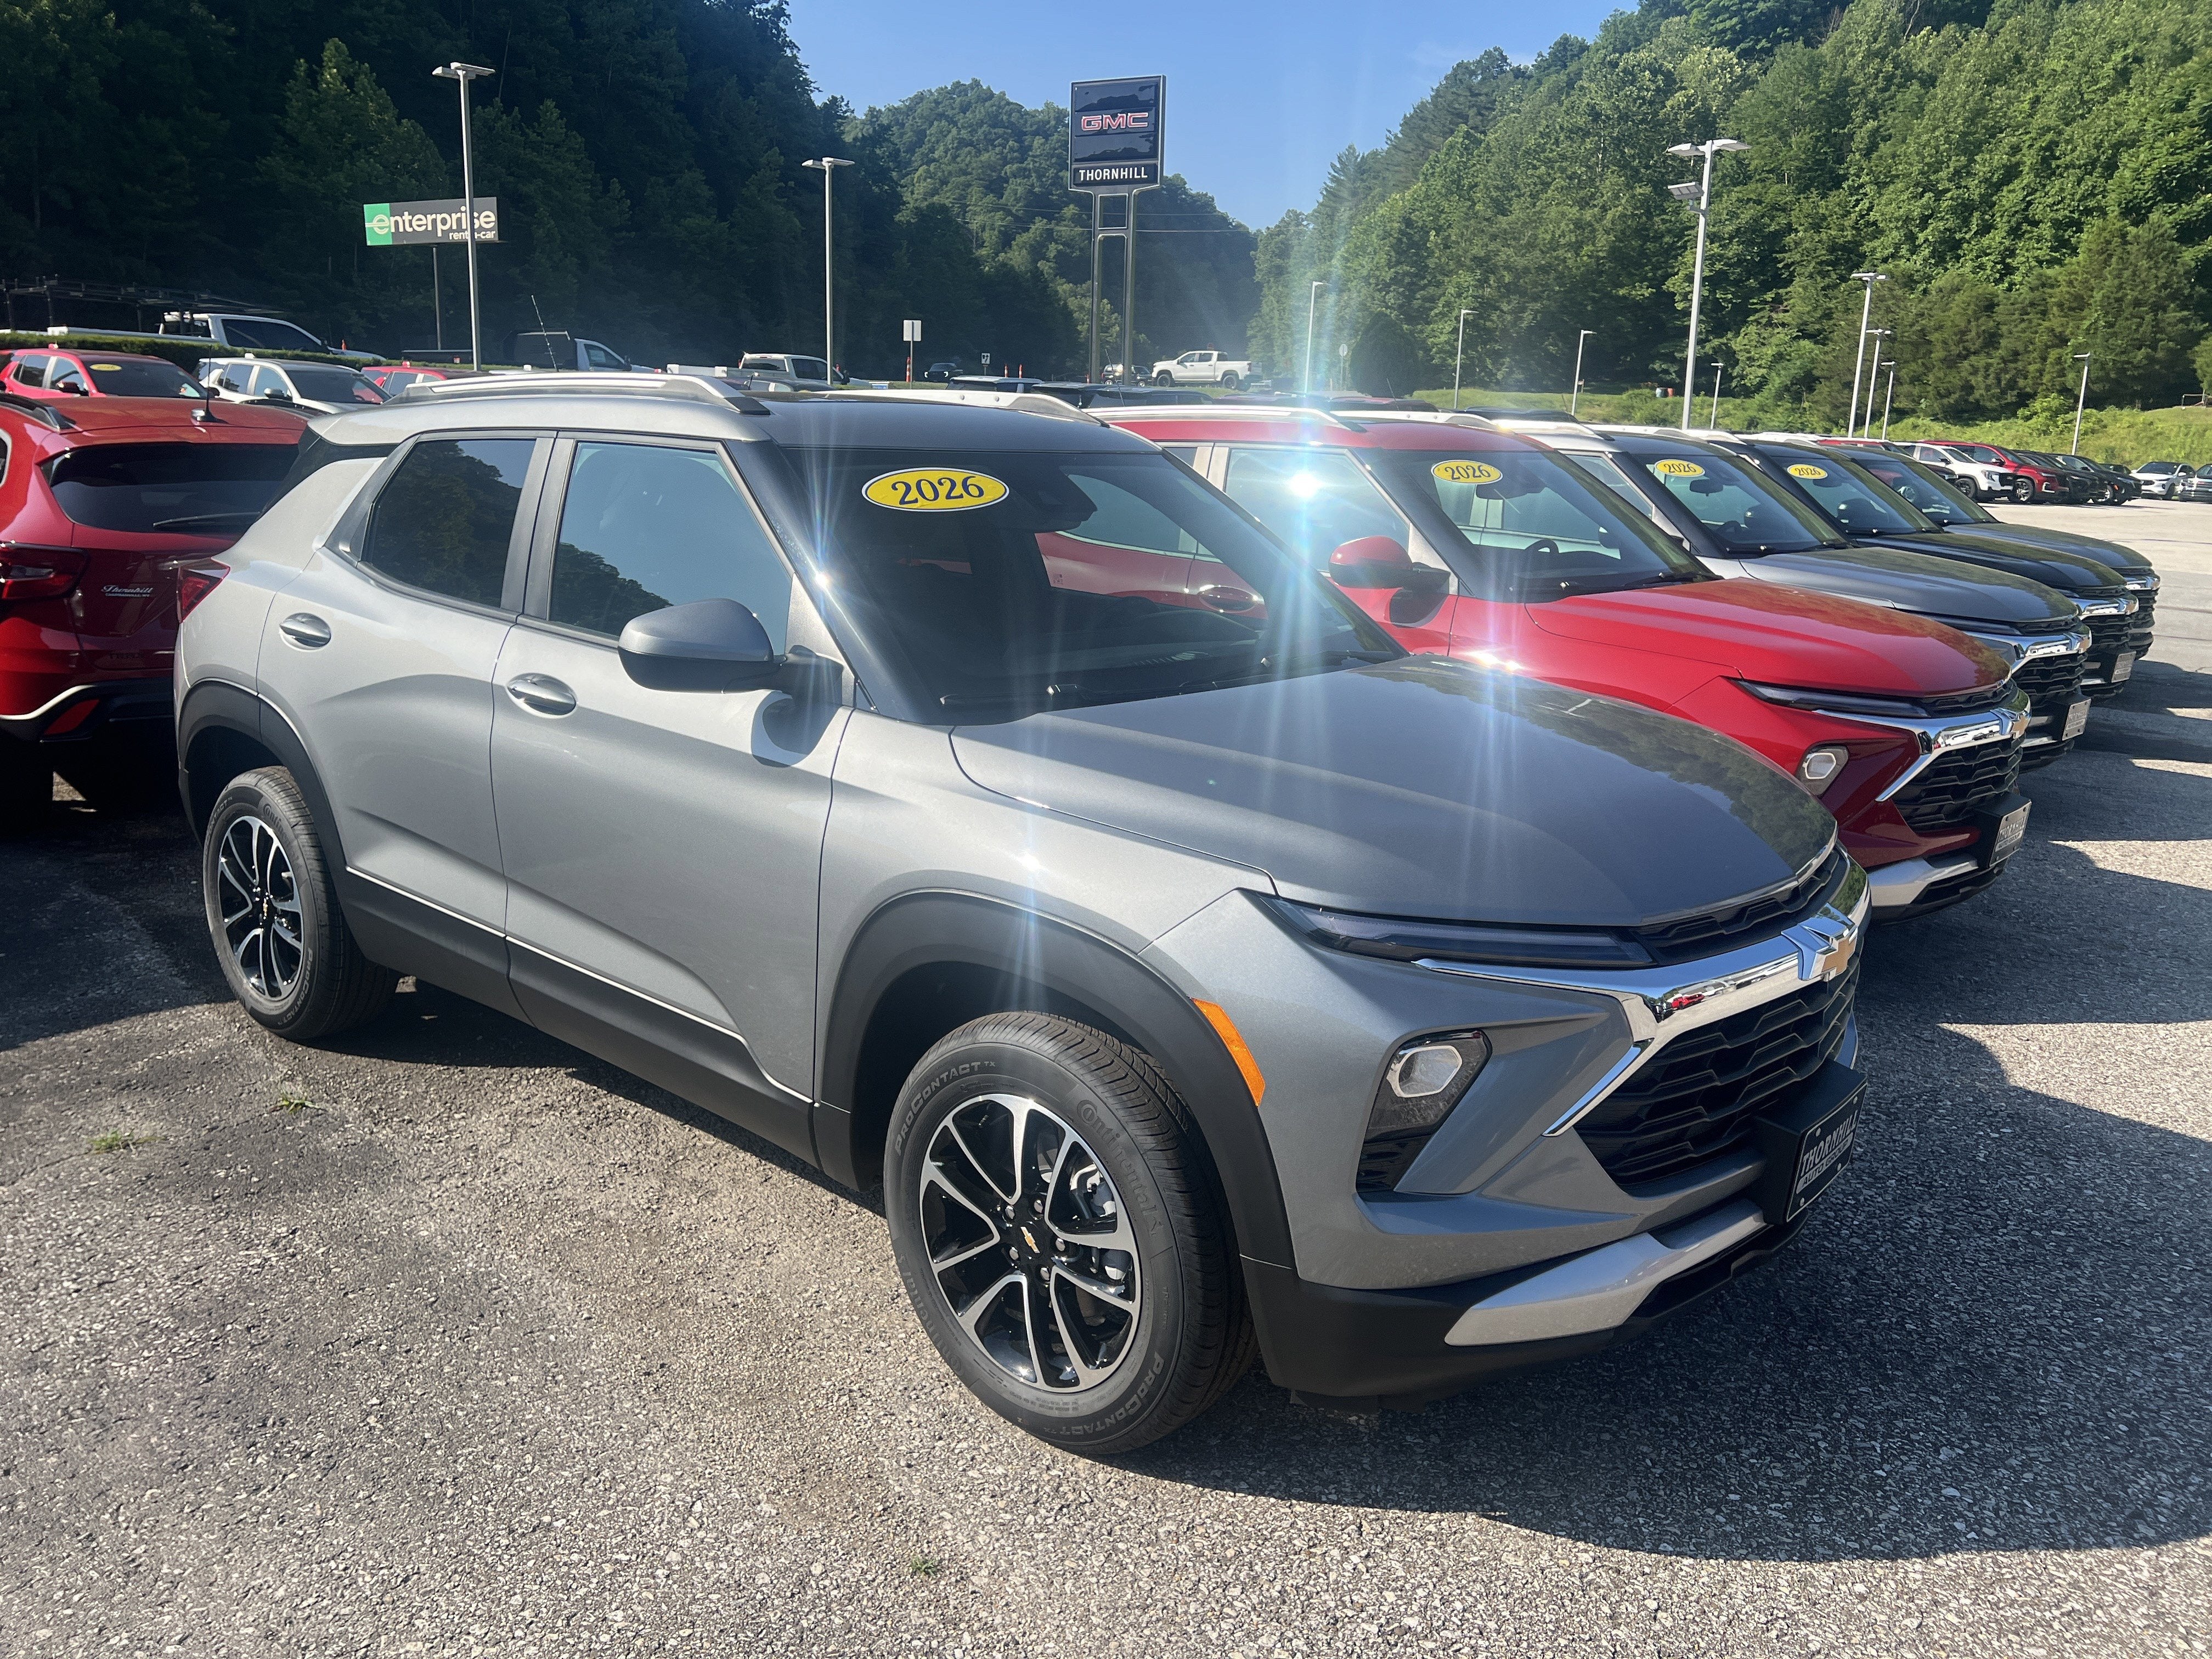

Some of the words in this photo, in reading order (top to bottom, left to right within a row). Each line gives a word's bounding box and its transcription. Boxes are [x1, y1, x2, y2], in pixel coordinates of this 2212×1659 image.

[1081, 112, 1148, 131] GMC
[1079, 167, 1148, 181] THORNHILL
[449, 230, 496, 240] rent-car
[1444, 465, 1491, 480] 2026
[1663, 463, 1696, 473] 2026
[1795, 467, 1821, 476] 2026
[891, 476, 984, 505] 2026
[895, 1062, 981, 1156] PROCONTACT
[1801, 1109, 1858, 1177] THORNHILL
[1077, 1099, 1158, 1216] Continental
[1802, 1164, 1824, 1187] AUTO
[1060, 1351, 1165, 1435] PROCONTACT
